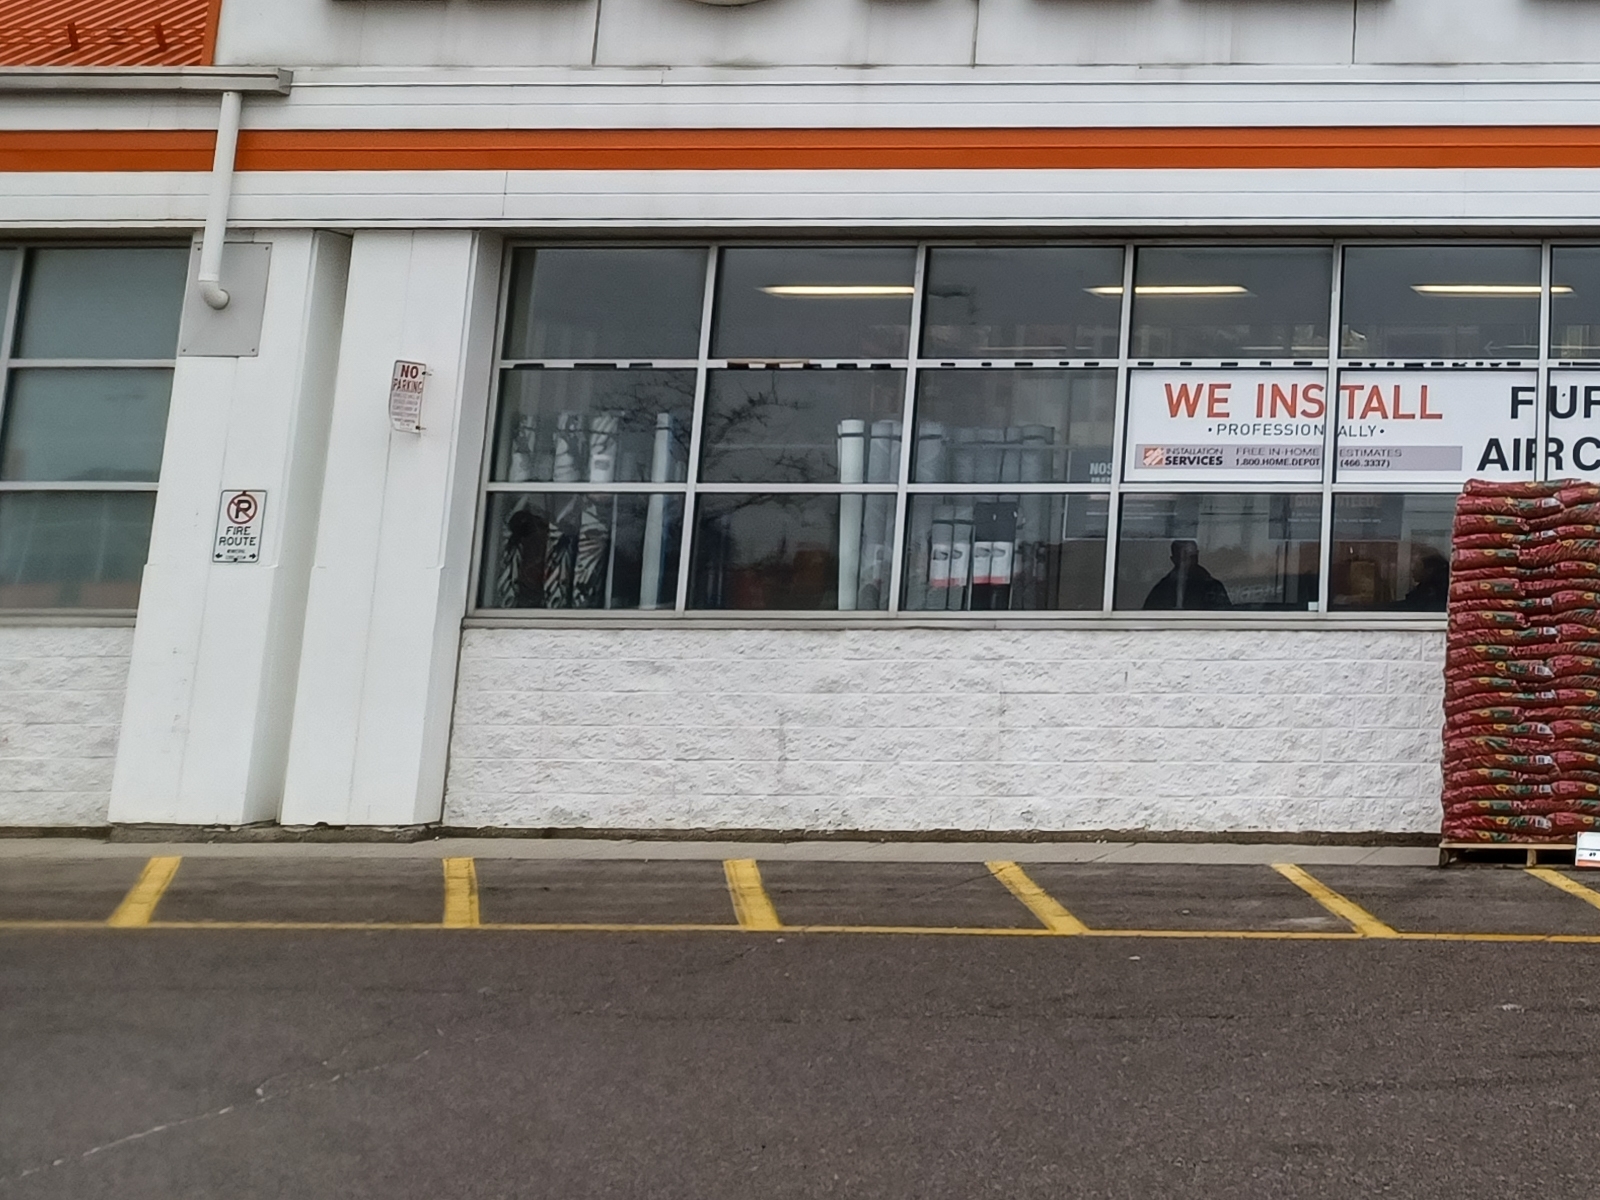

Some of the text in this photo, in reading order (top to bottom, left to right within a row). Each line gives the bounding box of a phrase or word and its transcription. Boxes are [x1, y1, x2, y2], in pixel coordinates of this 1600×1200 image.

[400, 364, 419, 379] NO
[1164, 382, 1443, 420] WE INSTALL
[1236, 447, 1265, 456] FREE
[1339, 449, 1403, 458] ESTIMATES
[1165, 455, 1224, 467] SERVICES
[226, 525, 252, 536] FIRE
[218, 536, 257, 547] ROUTE
